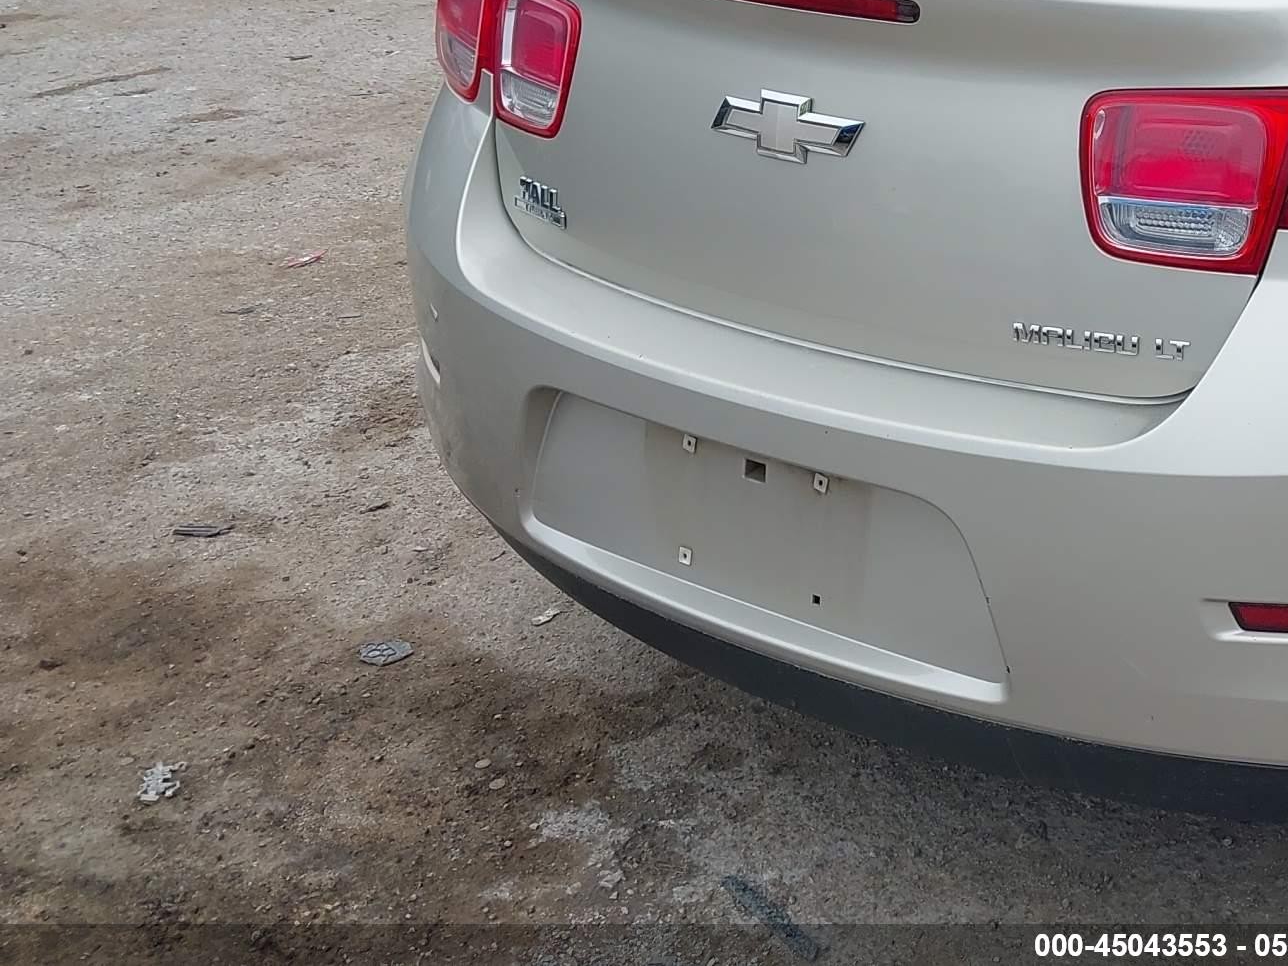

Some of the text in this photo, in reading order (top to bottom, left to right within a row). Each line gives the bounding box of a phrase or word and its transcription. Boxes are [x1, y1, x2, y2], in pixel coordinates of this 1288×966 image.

[519, 175, 561, 213] TALL
[1012, 321, 1191, 361] MALIBU LT
